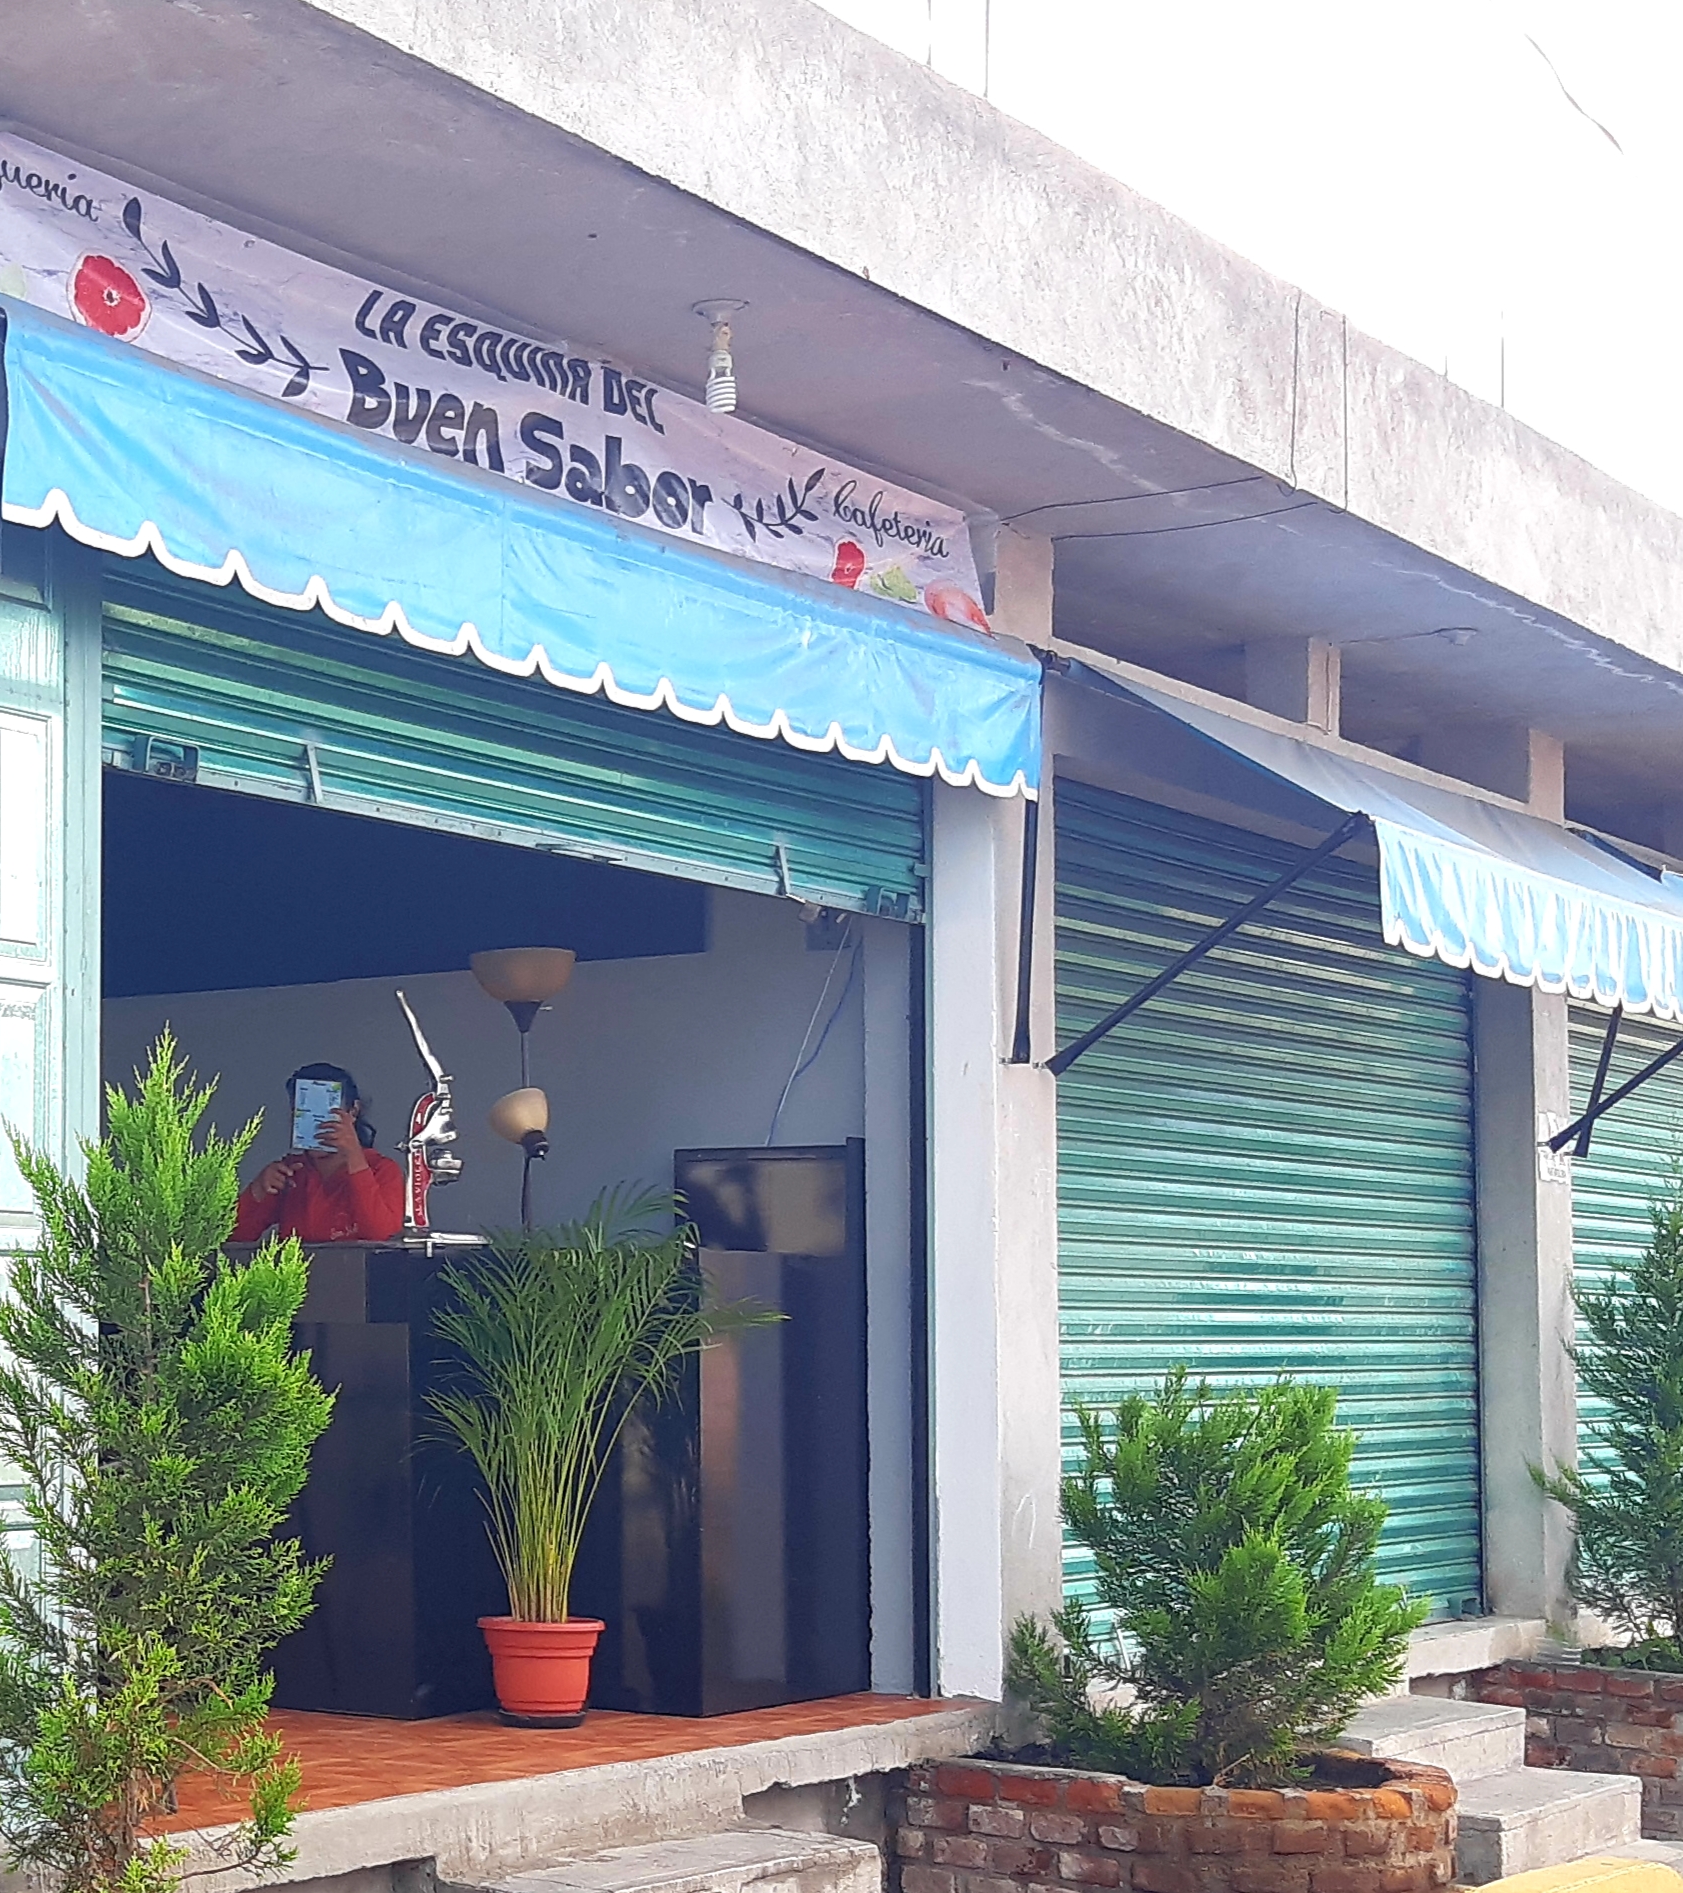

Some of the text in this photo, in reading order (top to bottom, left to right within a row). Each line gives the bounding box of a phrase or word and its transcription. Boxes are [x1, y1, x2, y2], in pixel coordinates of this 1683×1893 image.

[339, 348, 714, 535] Buen Sabor
[355, 289, 666, 435] LA ESQUINA DEL
